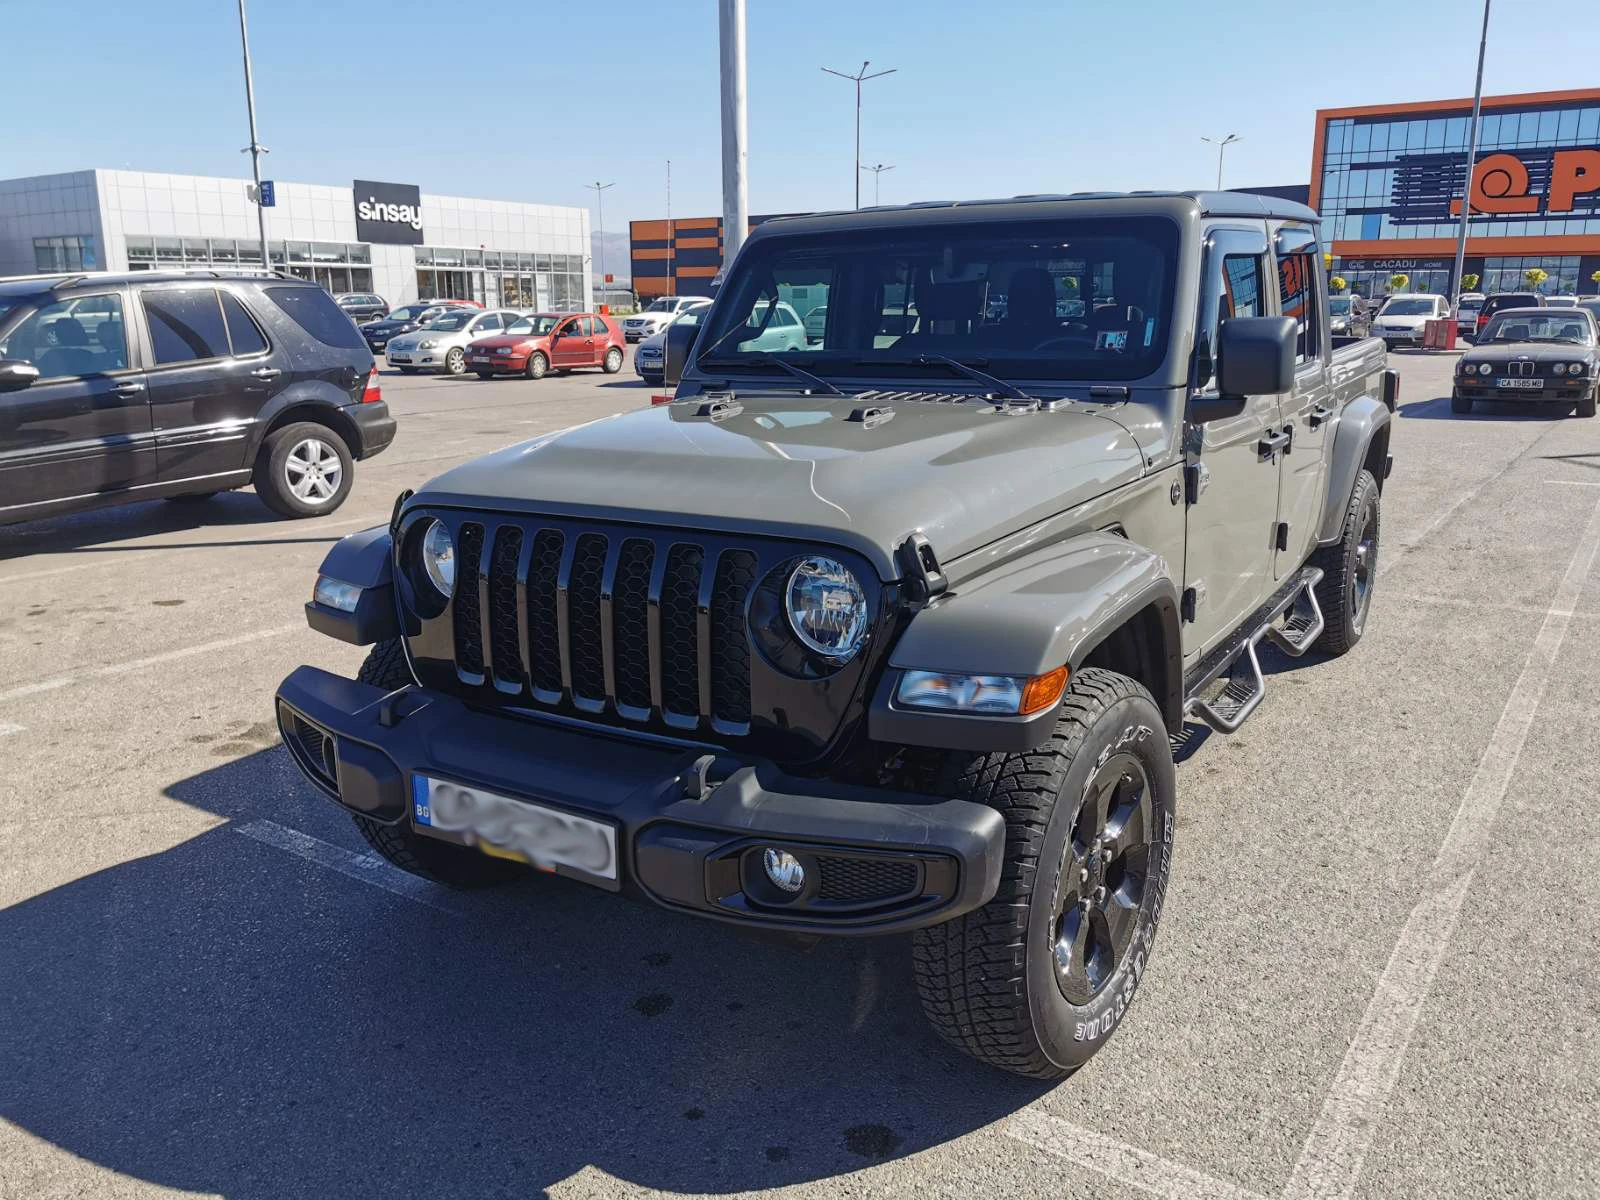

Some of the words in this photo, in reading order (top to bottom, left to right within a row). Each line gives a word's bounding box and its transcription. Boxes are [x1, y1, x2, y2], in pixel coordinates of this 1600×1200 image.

[358, 196, 423, 230] sinsay
[1373, 260, 1417, 268] CACADU
[416, 804, 429, 818] BG
